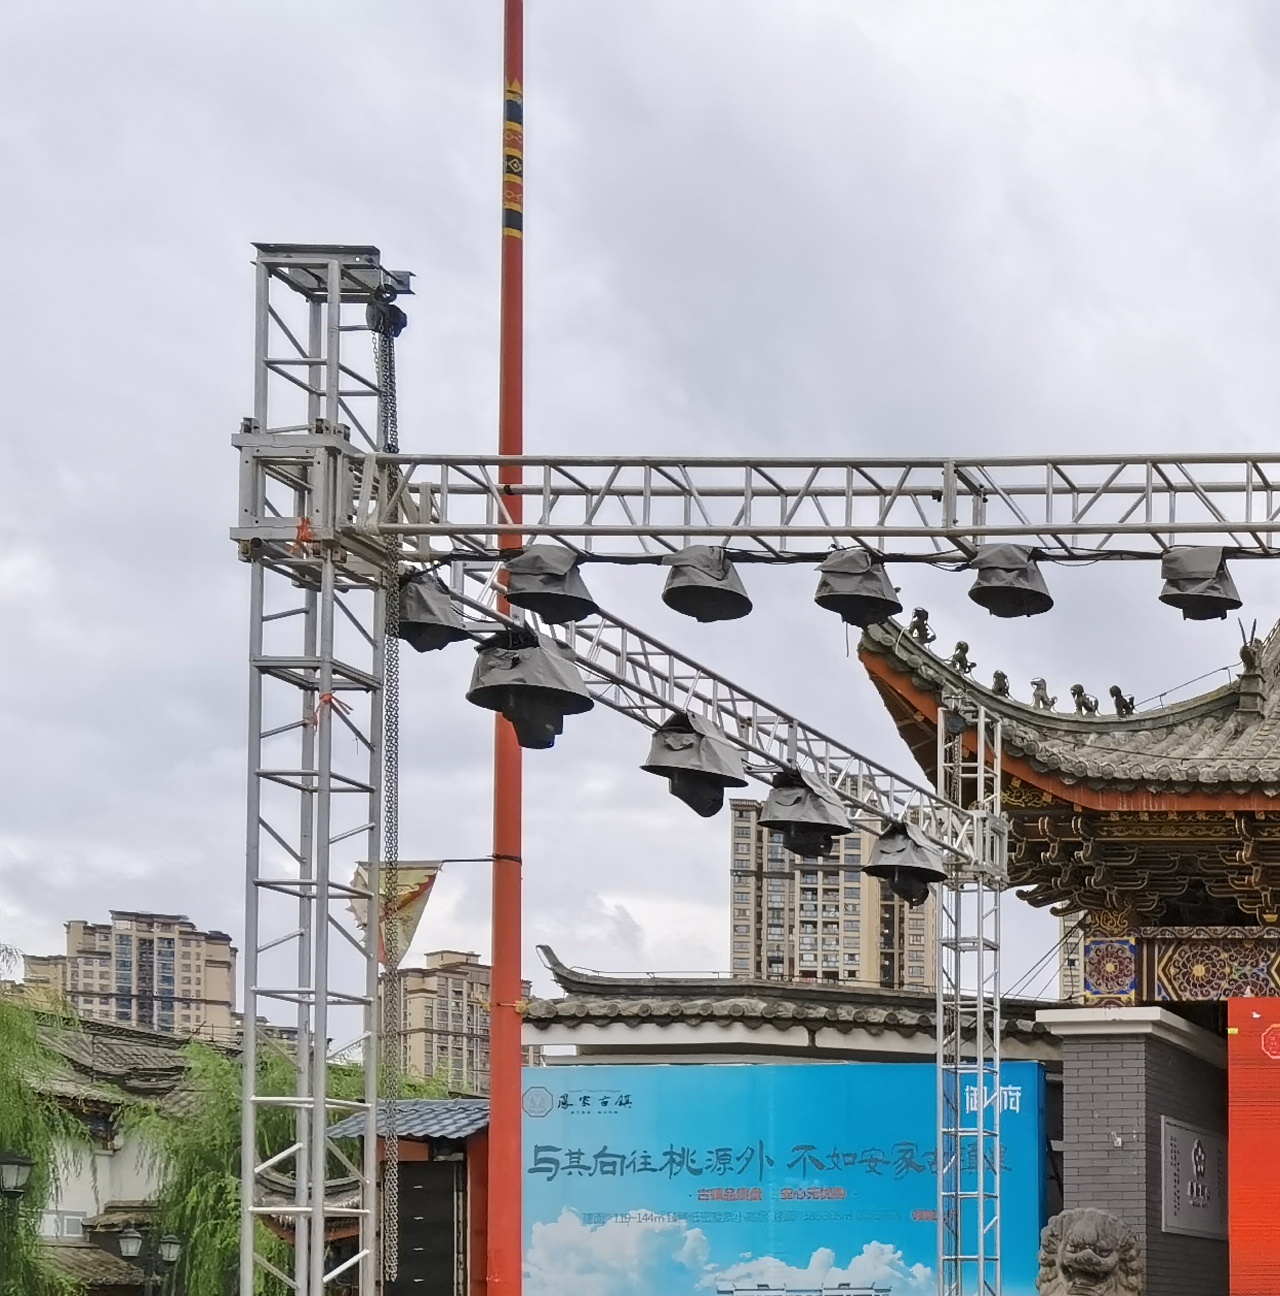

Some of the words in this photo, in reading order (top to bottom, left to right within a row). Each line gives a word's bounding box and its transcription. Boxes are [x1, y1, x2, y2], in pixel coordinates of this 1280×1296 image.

[527, 1140, 775, 1182] 与其向往桃源外
